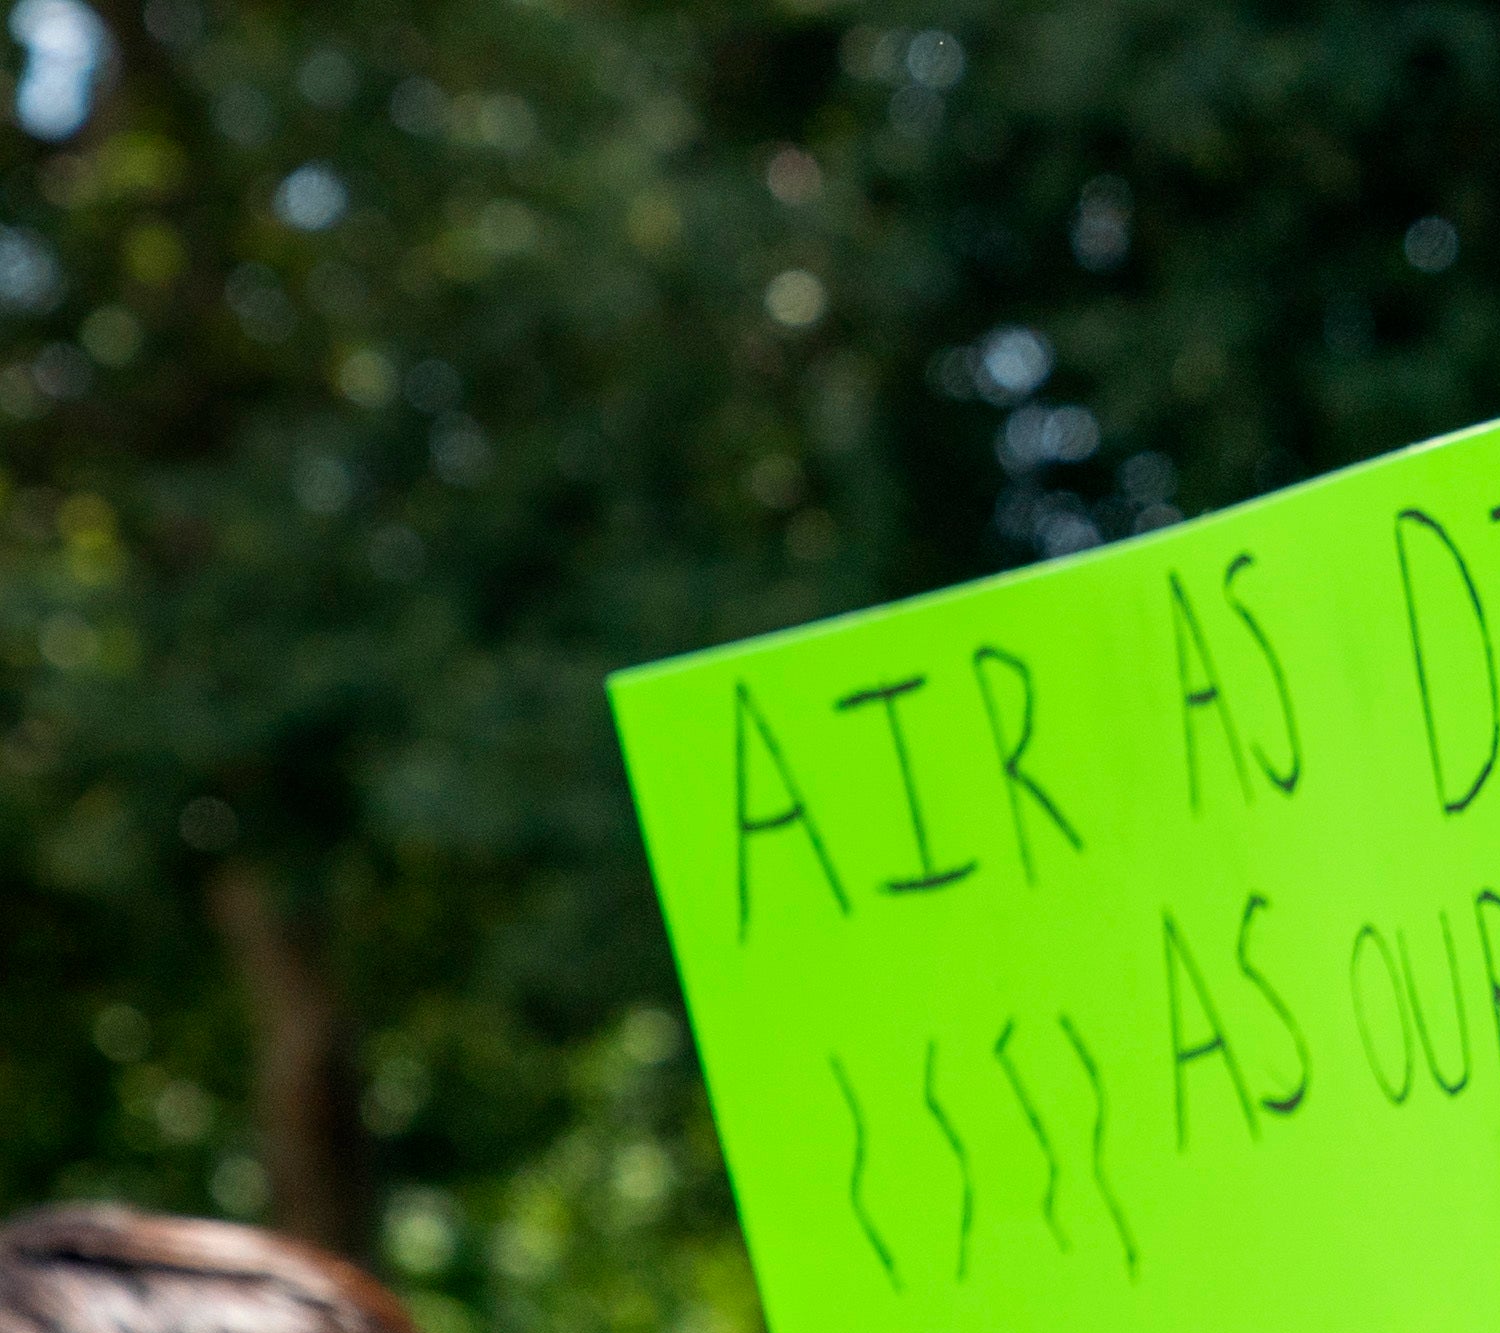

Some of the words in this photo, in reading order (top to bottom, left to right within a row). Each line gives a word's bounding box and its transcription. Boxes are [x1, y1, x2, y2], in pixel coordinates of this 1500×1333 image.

[732, 644, 1084, 946] AIR
[1170, 553, 1300, 817] AS
[1160, 894, 1313, 1154] AS
